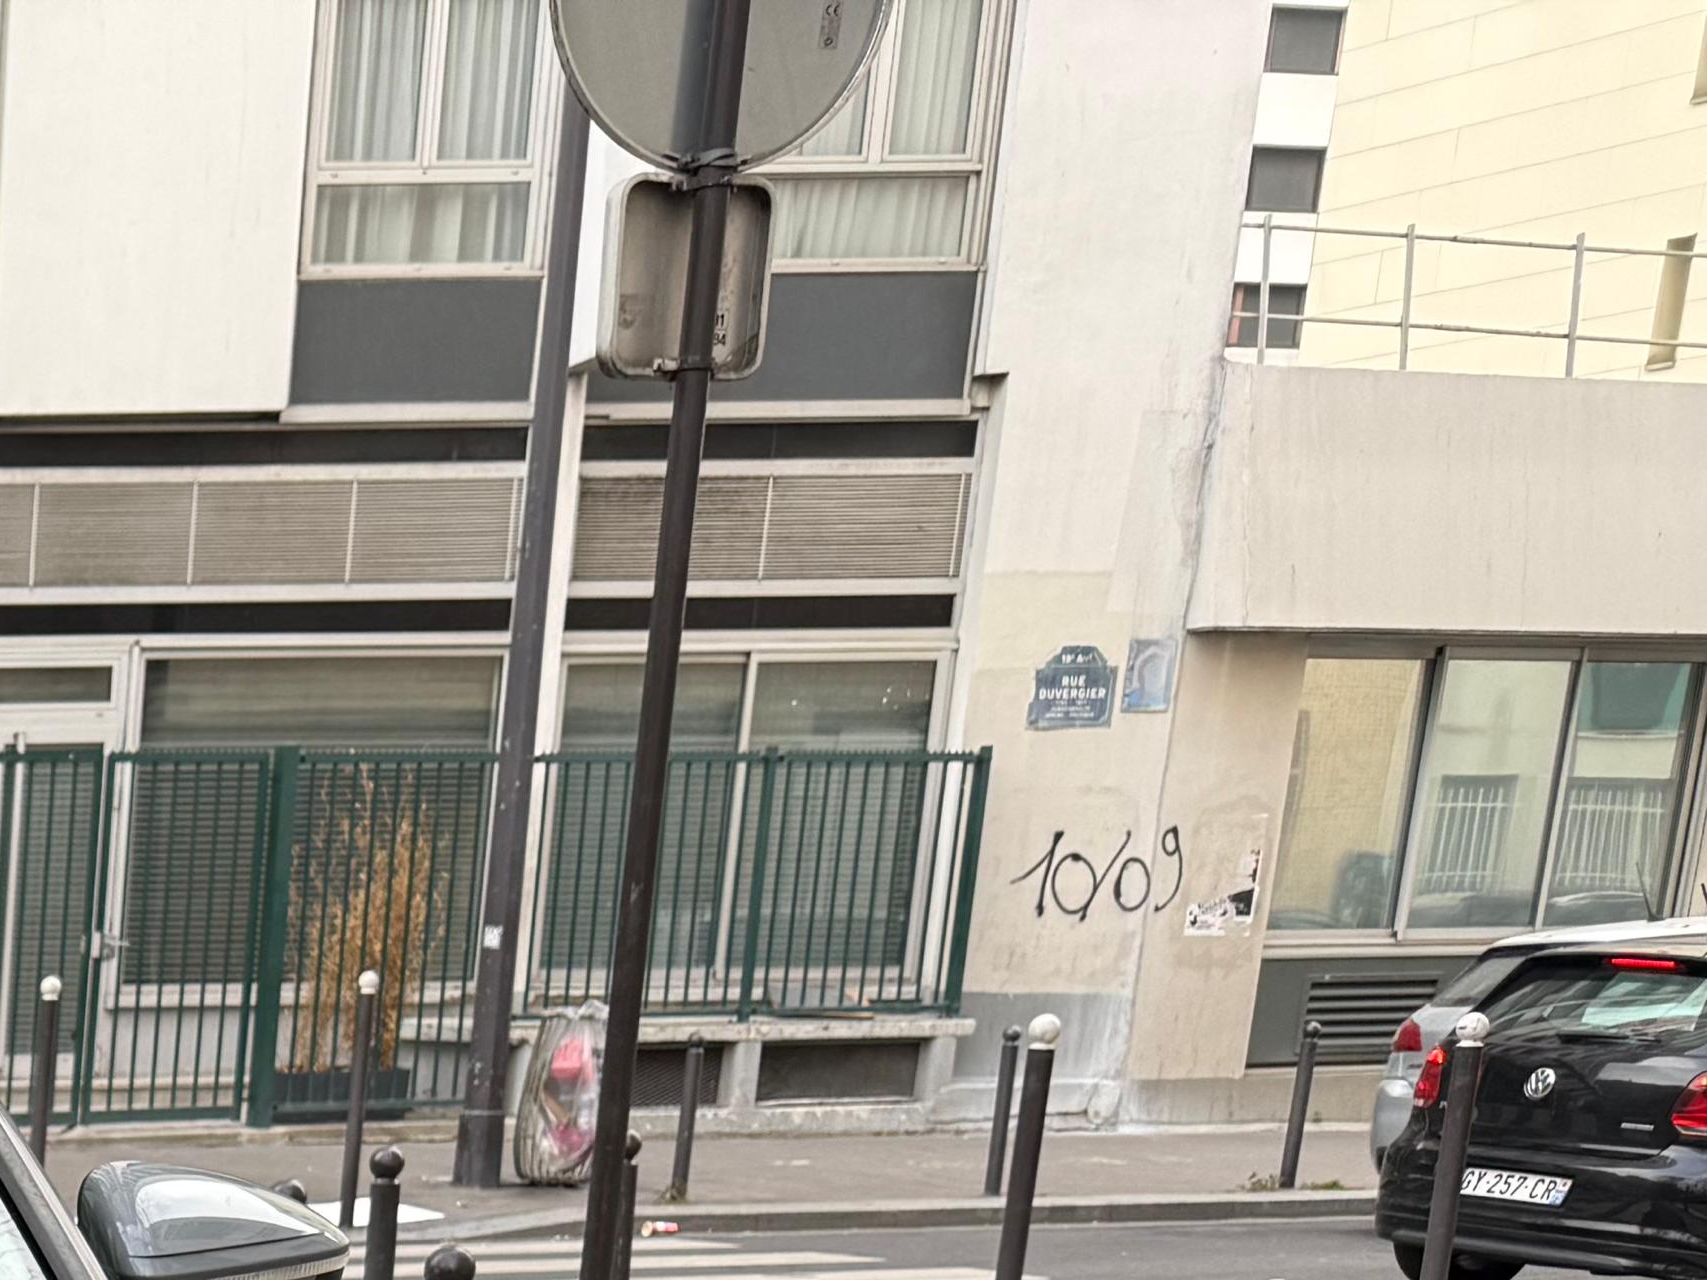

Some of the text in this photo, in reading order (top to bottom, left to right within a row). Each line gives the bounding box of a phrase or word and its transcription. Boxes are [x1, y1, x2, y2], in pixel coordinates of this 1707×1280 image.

[1061, 675, 1086, 687] RUE
[1039, 687, 1106, 700] DUVERGIER
[1010, 825, 1183, 922] 10/09
